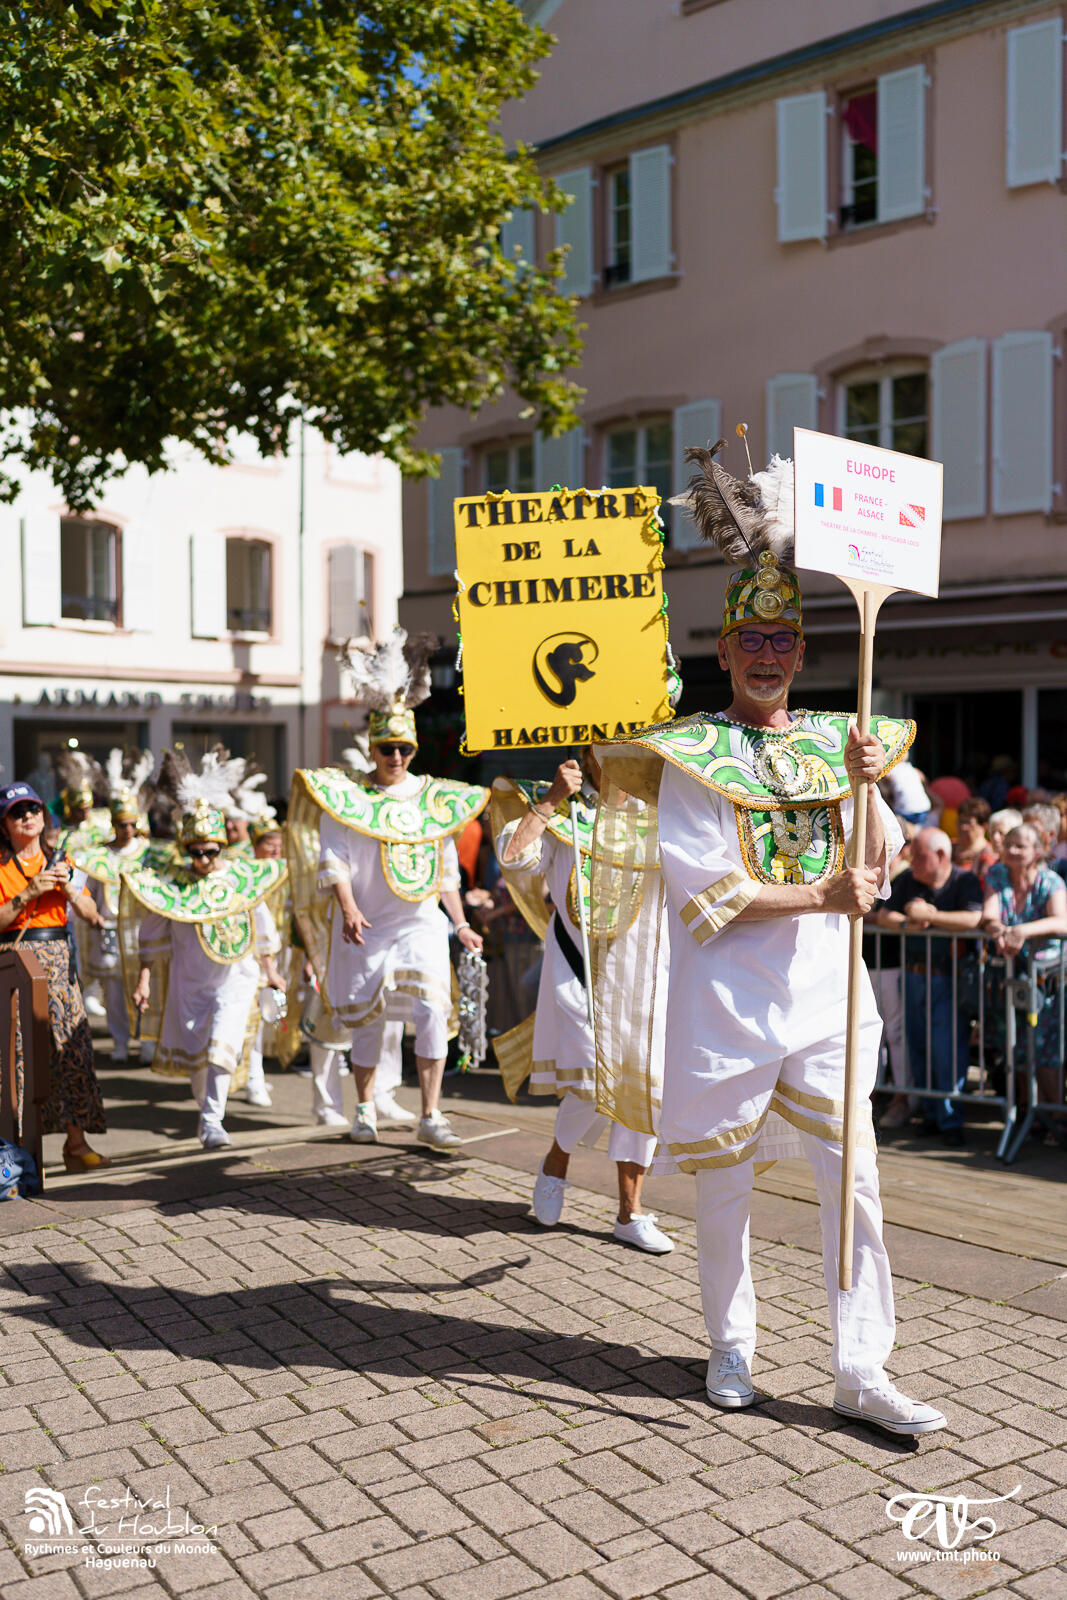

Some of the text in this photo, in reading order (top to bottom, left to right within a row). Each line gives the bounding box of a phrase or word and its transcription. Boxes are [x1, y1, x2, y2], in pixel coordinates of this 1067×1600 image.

[846, 460, 896, 483] EUROPE
[459, 492, 649, 528] THEATRE
[854, 492, 884, 507] FRANCE
[857, 507, 885, 521] ALSACE
[502, 538, 601, 562] DE LA
[468, 573, 656, 607] CHIMERE
[34, 688, 163, 710] ARMAND
